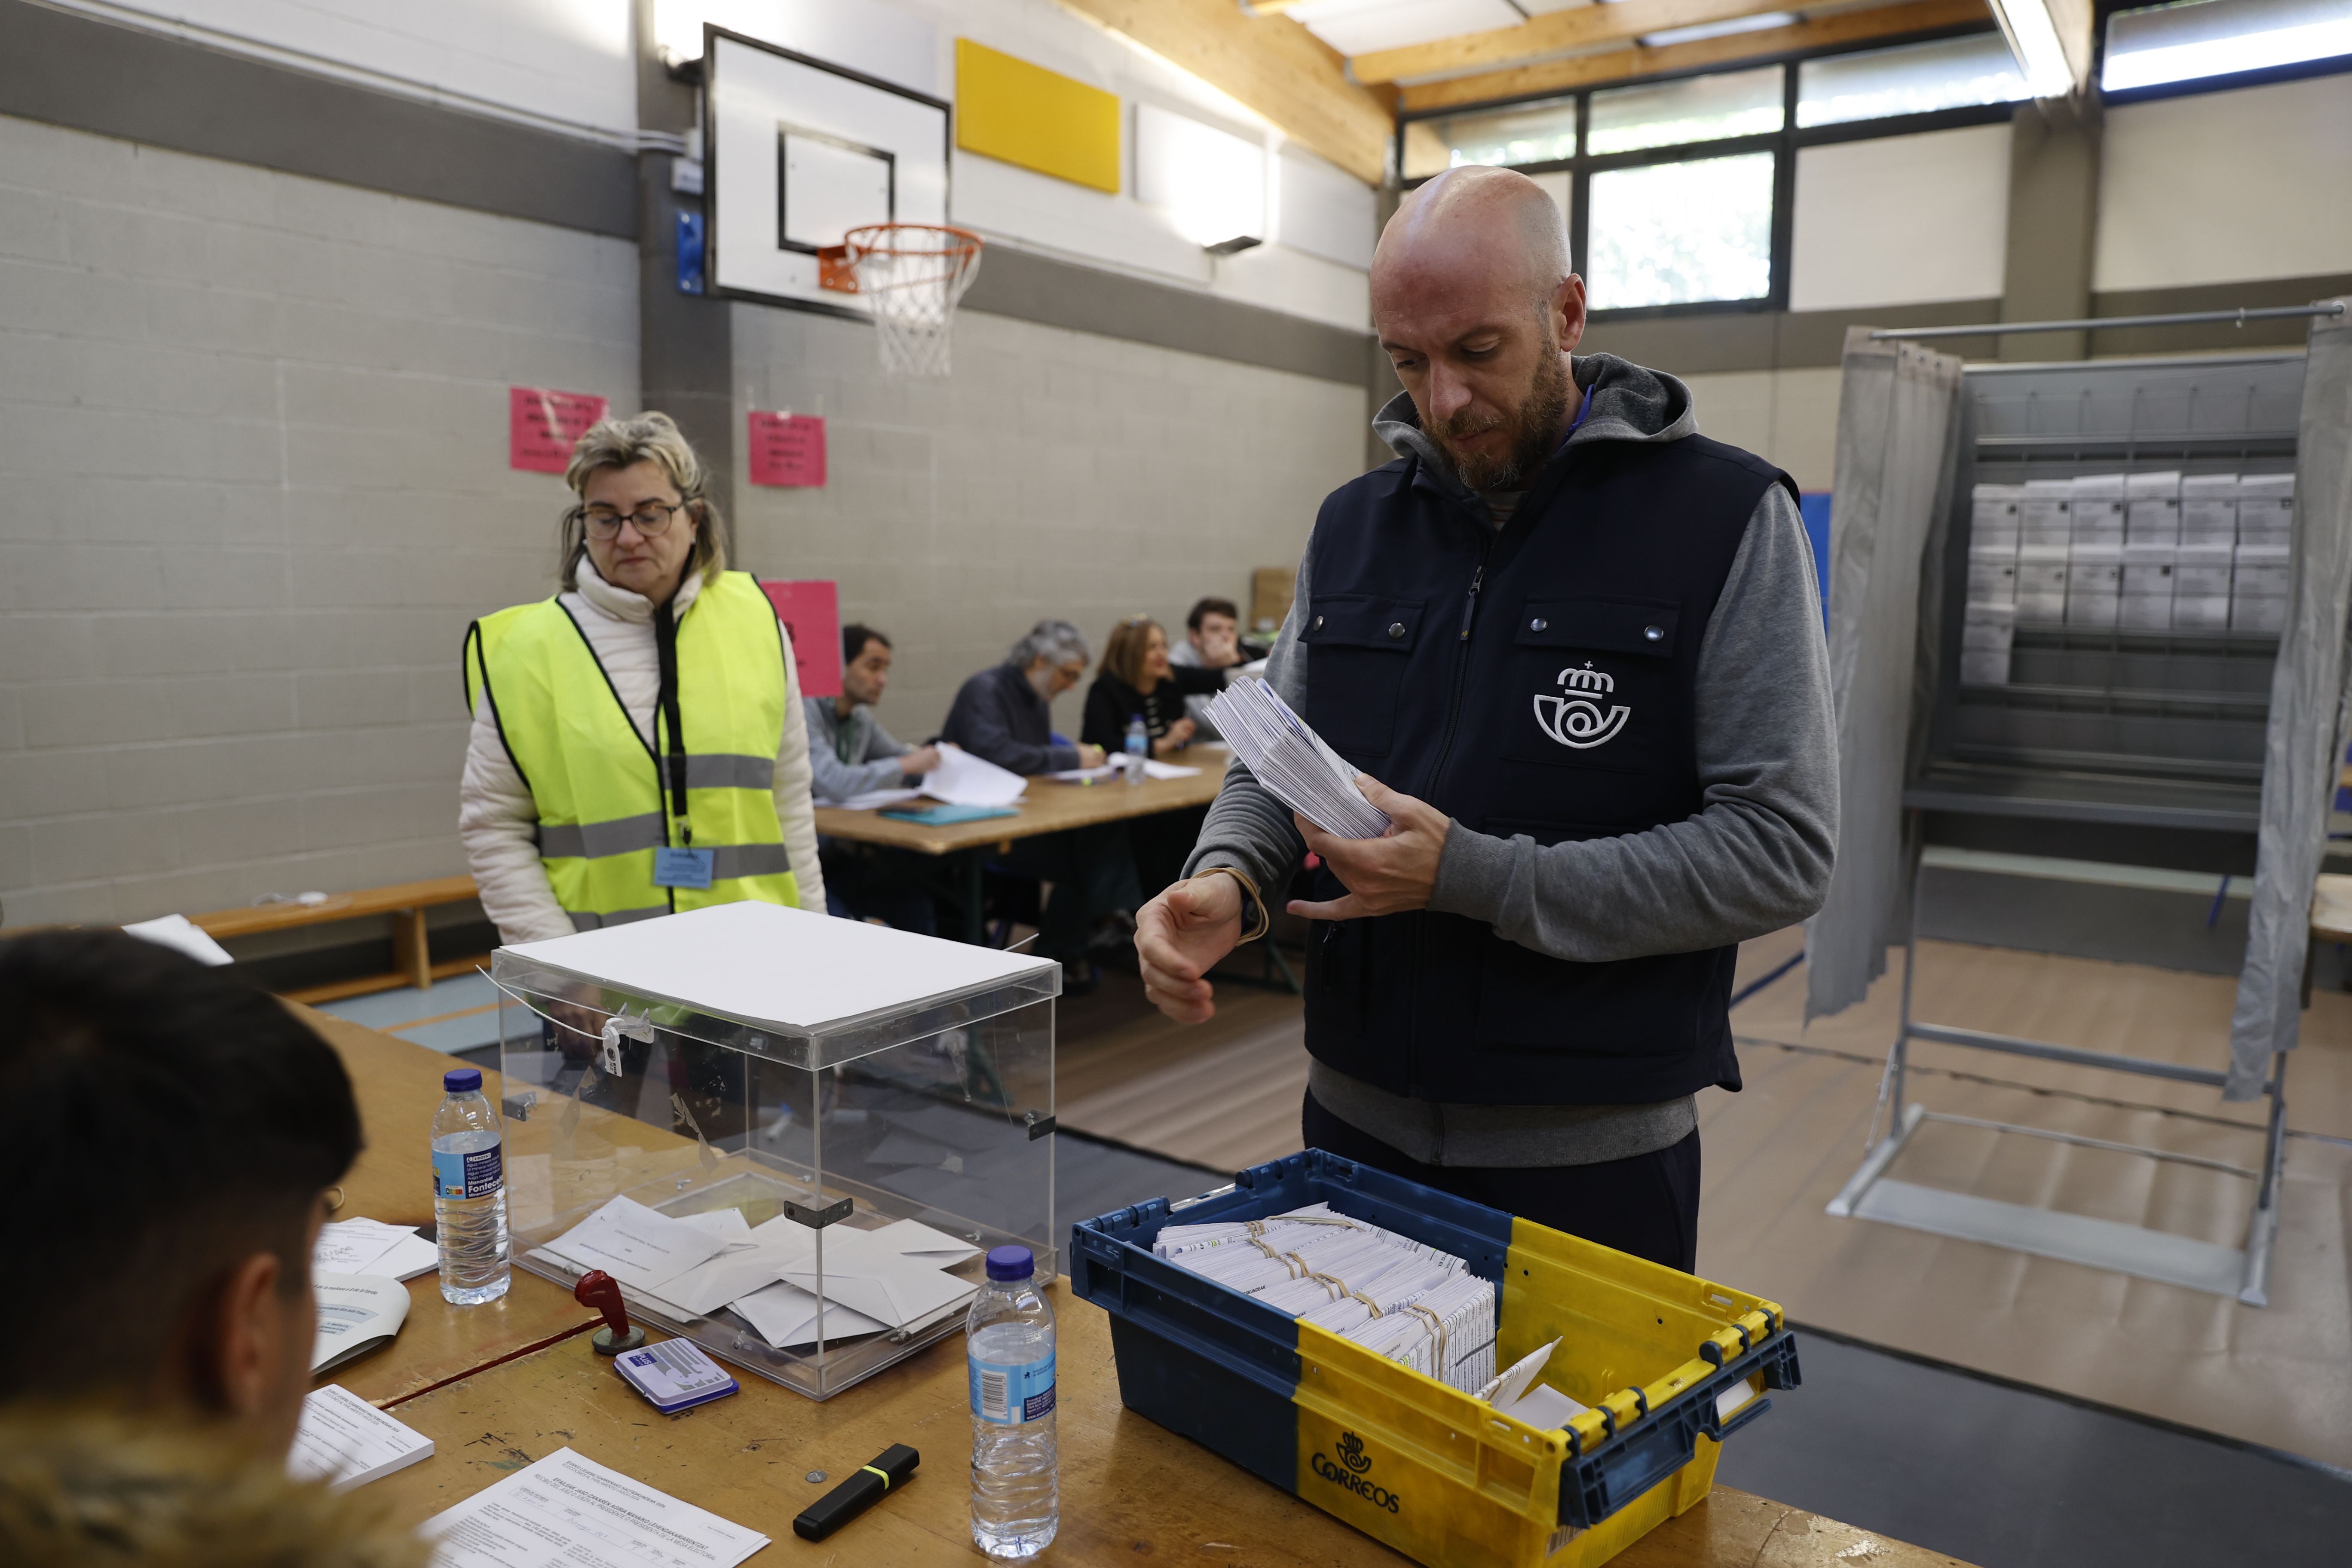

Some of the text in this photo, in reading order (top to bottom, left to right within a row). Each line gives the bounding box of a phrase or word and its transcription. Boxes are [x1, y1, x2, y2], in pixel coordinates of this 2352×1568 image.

[468, 1176, 493, 1185] Manantial
[637, 1354, 652, 1365] PLUS
[560, 1463, 588, 1476] ELECCIONES
[589, 1477, 618, 1491] PARLAMENTO
[565, 1461, 582, 1469] EUSKO
[579, 1467, 623, 1488] LEGEBILTZARRERAKO
[620, 1486, 657, 1504] HAUTESKUNDEAK
[1311, 1452, 1400, 1514] CORREOS
[532, 1473, 554, 1484] RECIBO
[574, 1494, 592, 1503] JUEZA
[595, 1504, 627, 1519] PRESIDENTE
[628, 1518, 662, 1535] PRESIDENTA
[672, 1539, 690, 1548] MESA
[686, 1545, 721, 1562] ELECTORAL
[551, 1477, 577, 1490] EPAILEAK
[587, 1494, 612, 1506] IZANAREN
[609, 1504, 628, 1513] AGIRIA
[625, 1511, 651, 1523] MAHAIKO
[647, 1521, 709, 1550] LEHENDAKARIARENTZAT
